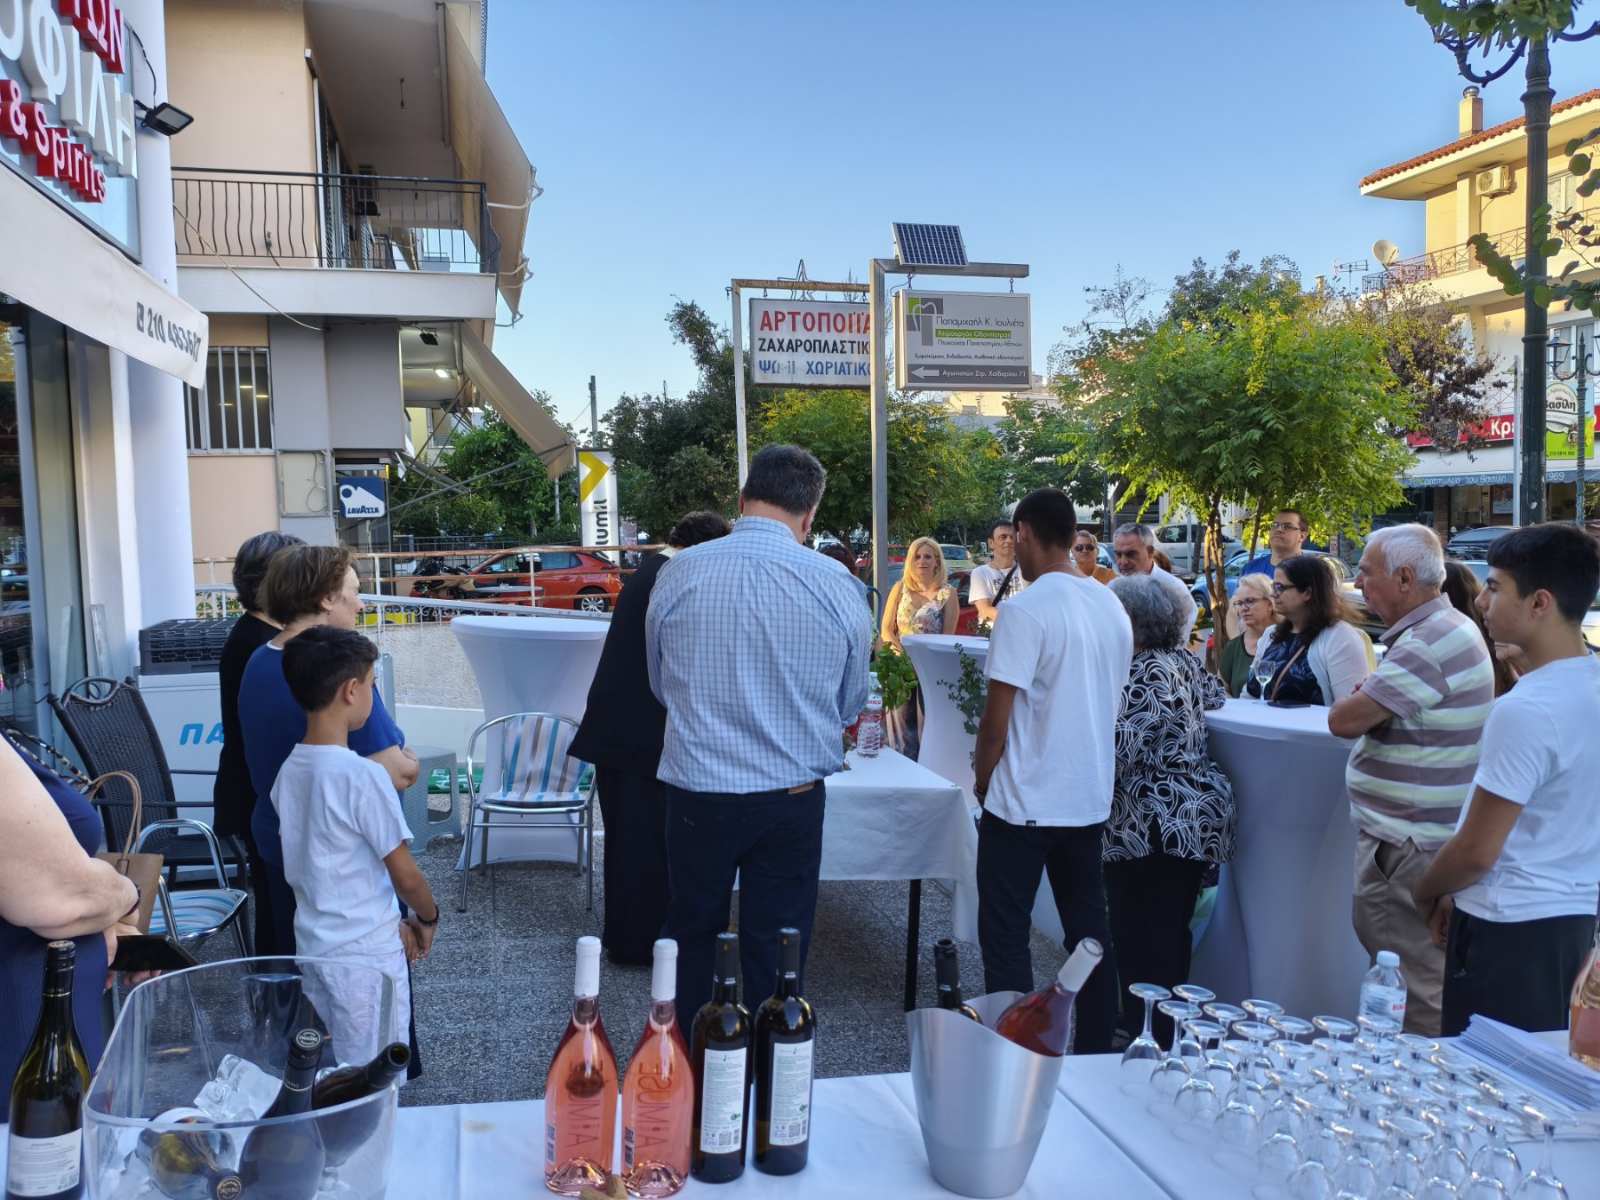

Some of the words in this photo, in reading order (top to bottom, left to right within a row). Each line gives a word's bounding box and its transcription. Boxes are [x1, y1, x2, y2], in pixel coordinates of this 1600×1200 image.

[34, 101, 107, 203] Spirits
[147, 307, 166, 343] 210
[758, 338, 870, 354] ΖΑΧΑΡΟΠΛΑΣΤΙΚ
